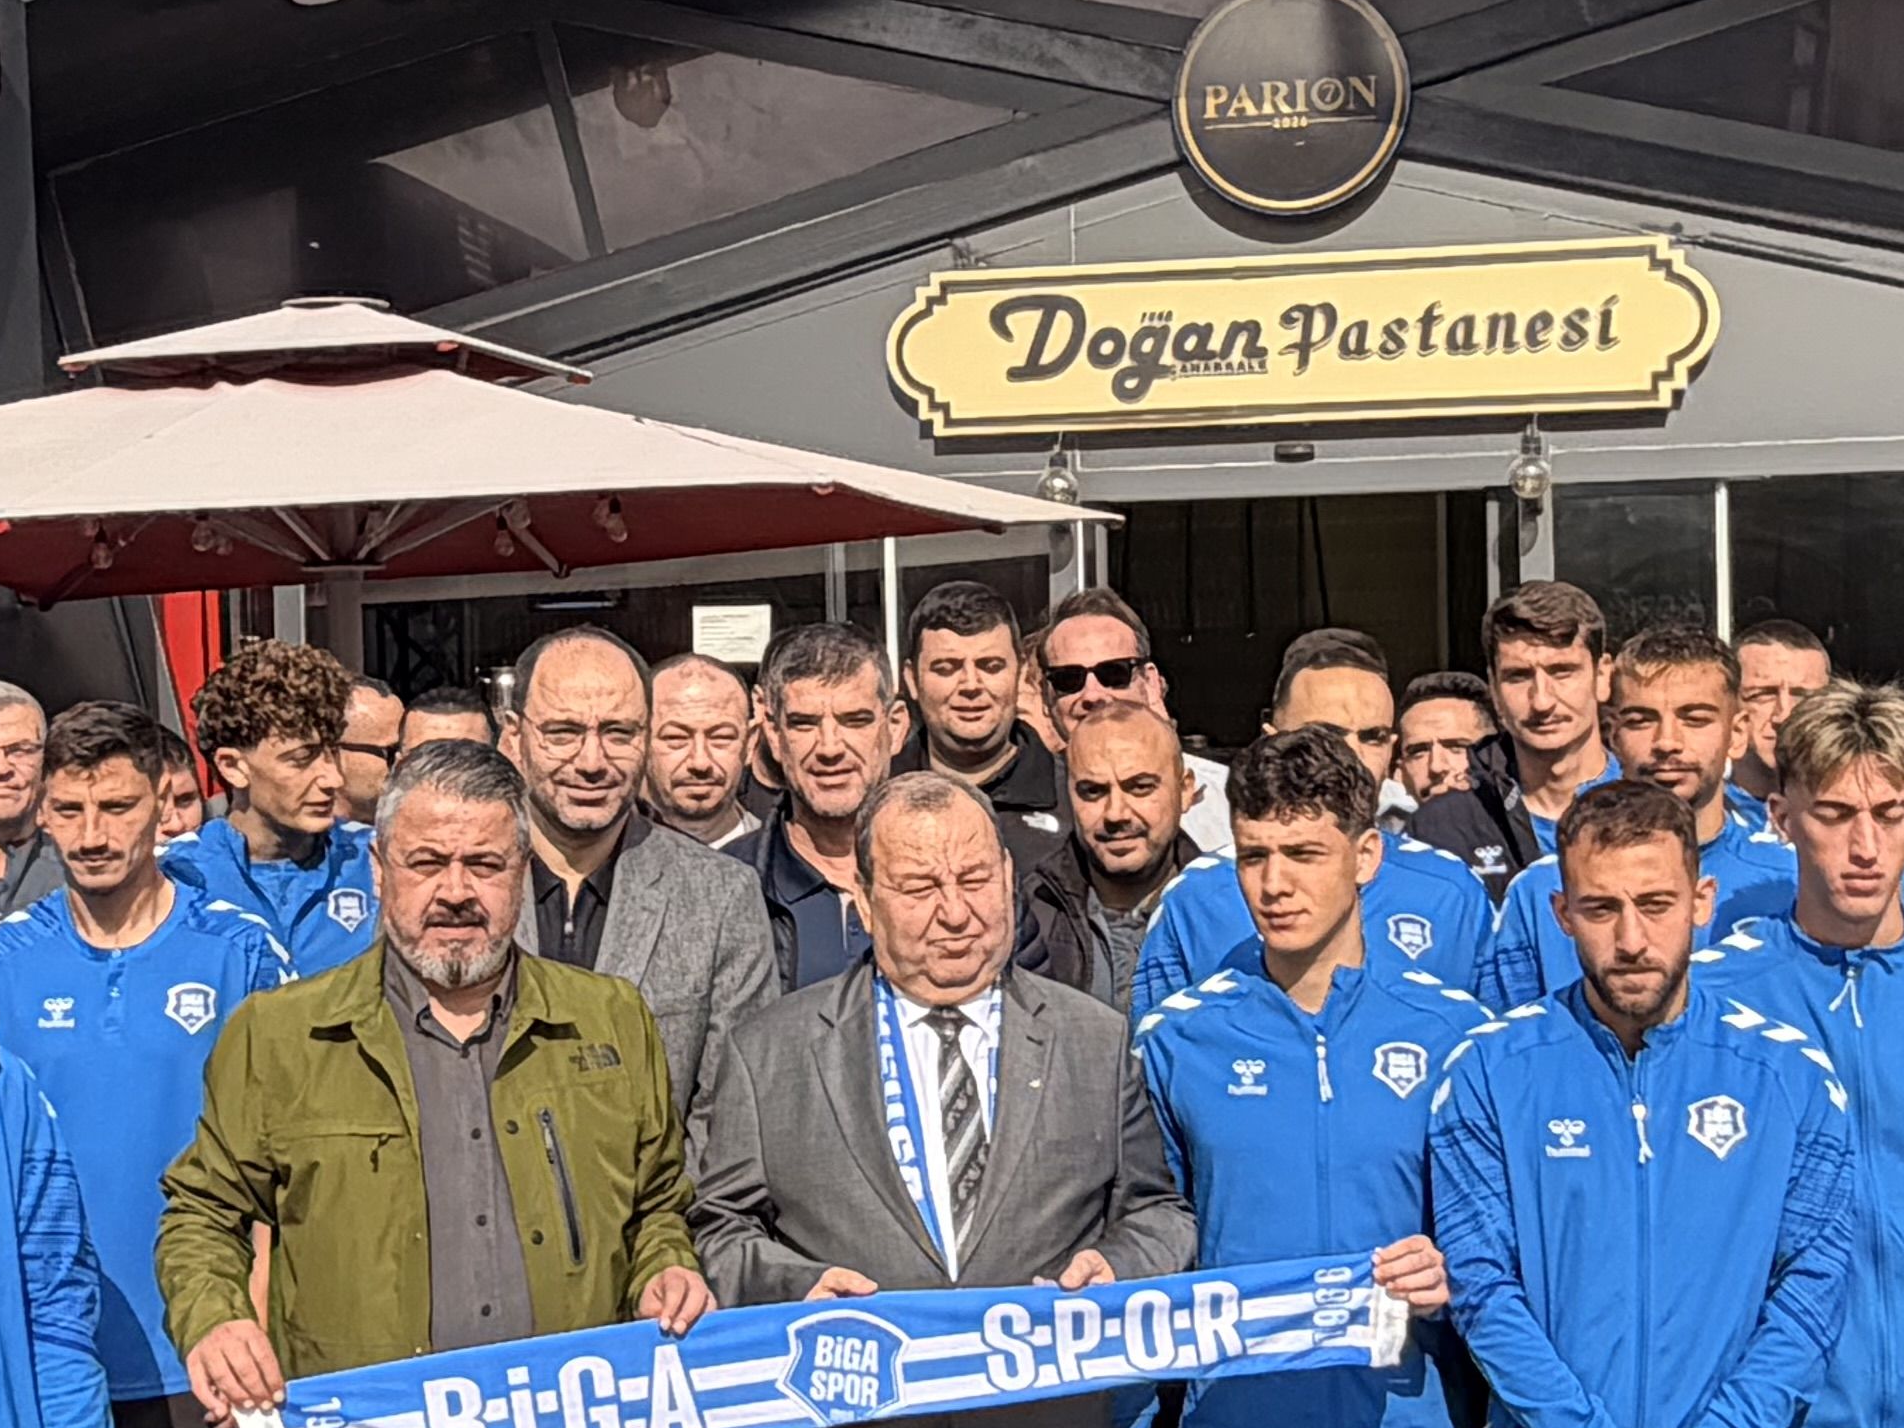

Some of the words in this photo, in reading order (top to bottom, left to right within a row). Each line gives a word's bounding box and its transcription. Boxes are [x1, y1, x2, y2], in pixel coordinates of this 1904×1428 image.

[1278, 294, 1623, 379] Pastanesi
[983, 1280, 1245, 1393] SPOR
[808, 1369, 880, 1408] SPOR
